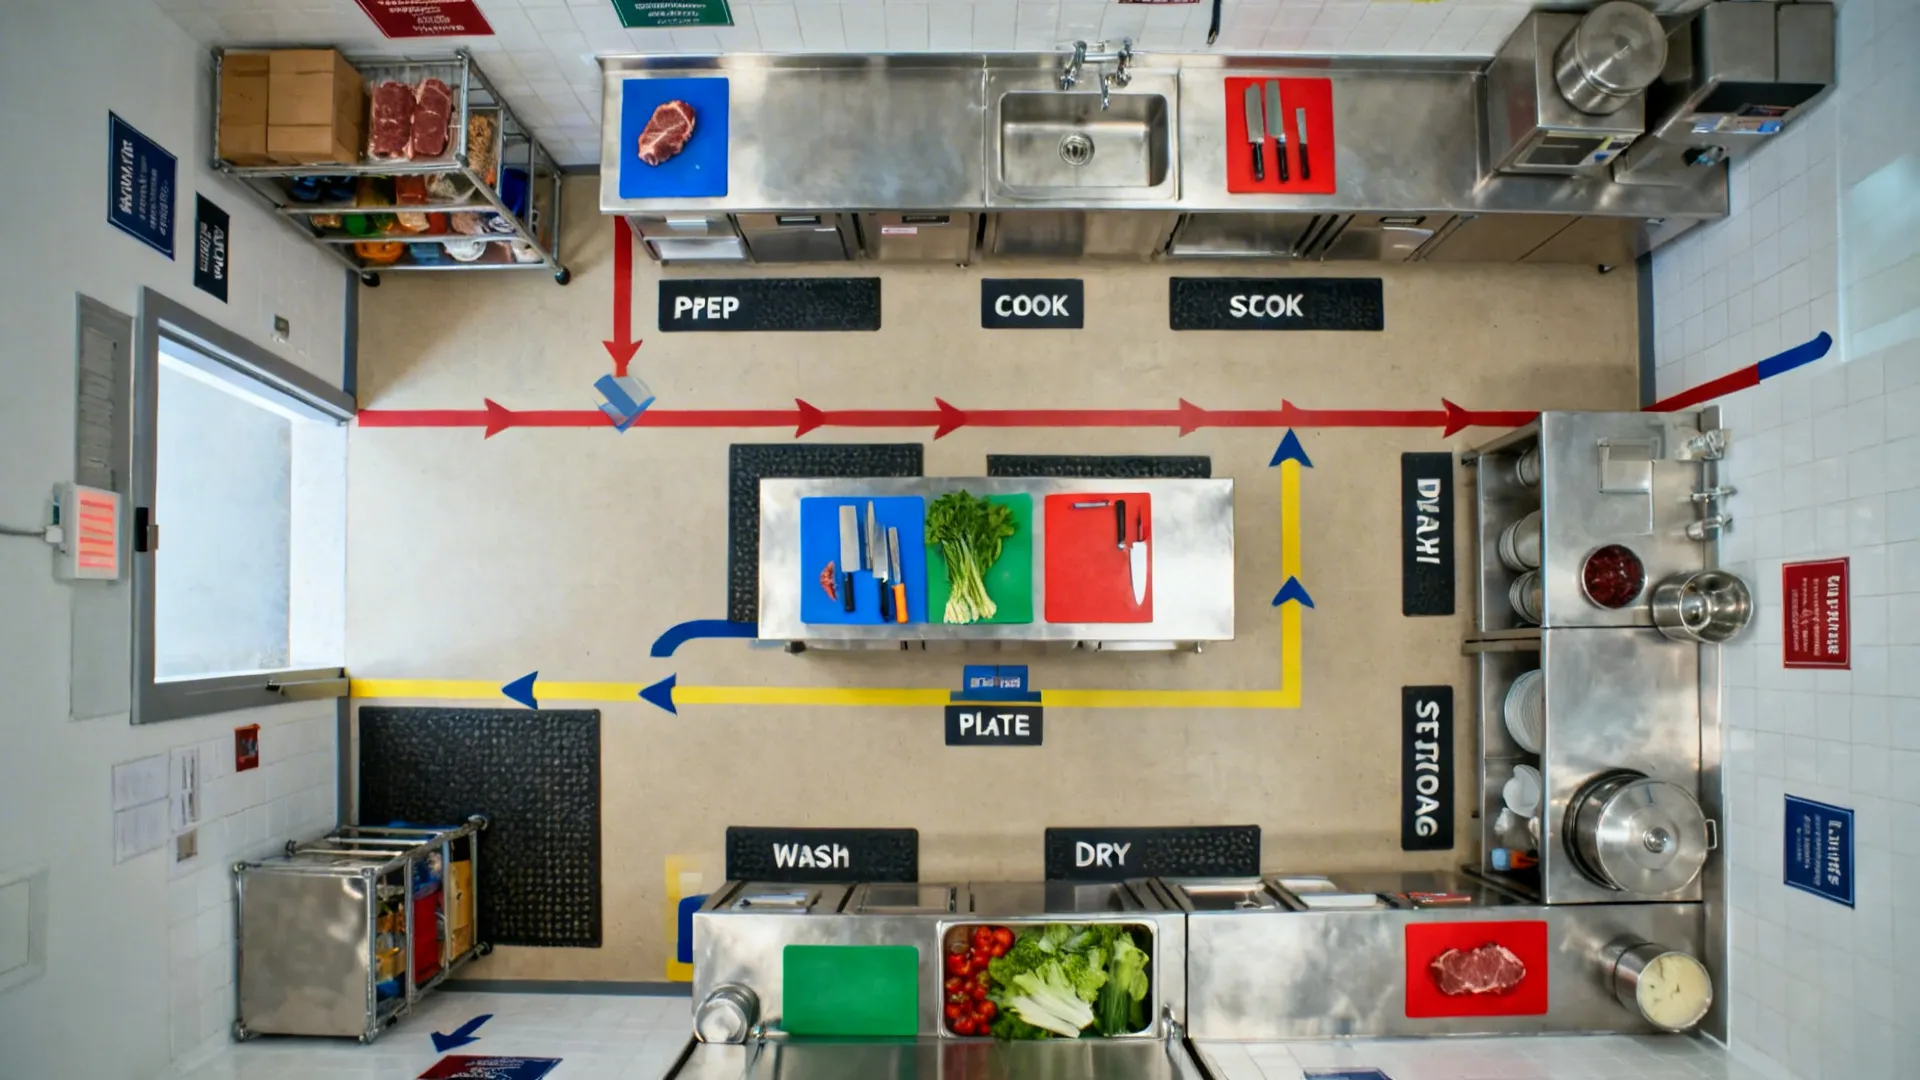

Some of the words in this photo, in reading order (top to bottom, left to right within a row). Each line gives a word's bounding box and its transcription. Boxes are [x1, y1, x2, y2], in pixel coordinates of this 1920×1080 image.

[995, 294, 1069, 317] COOK
[959, 711, 1030, 736] PLATE
[1075, 841, 1131, 867] DRY
